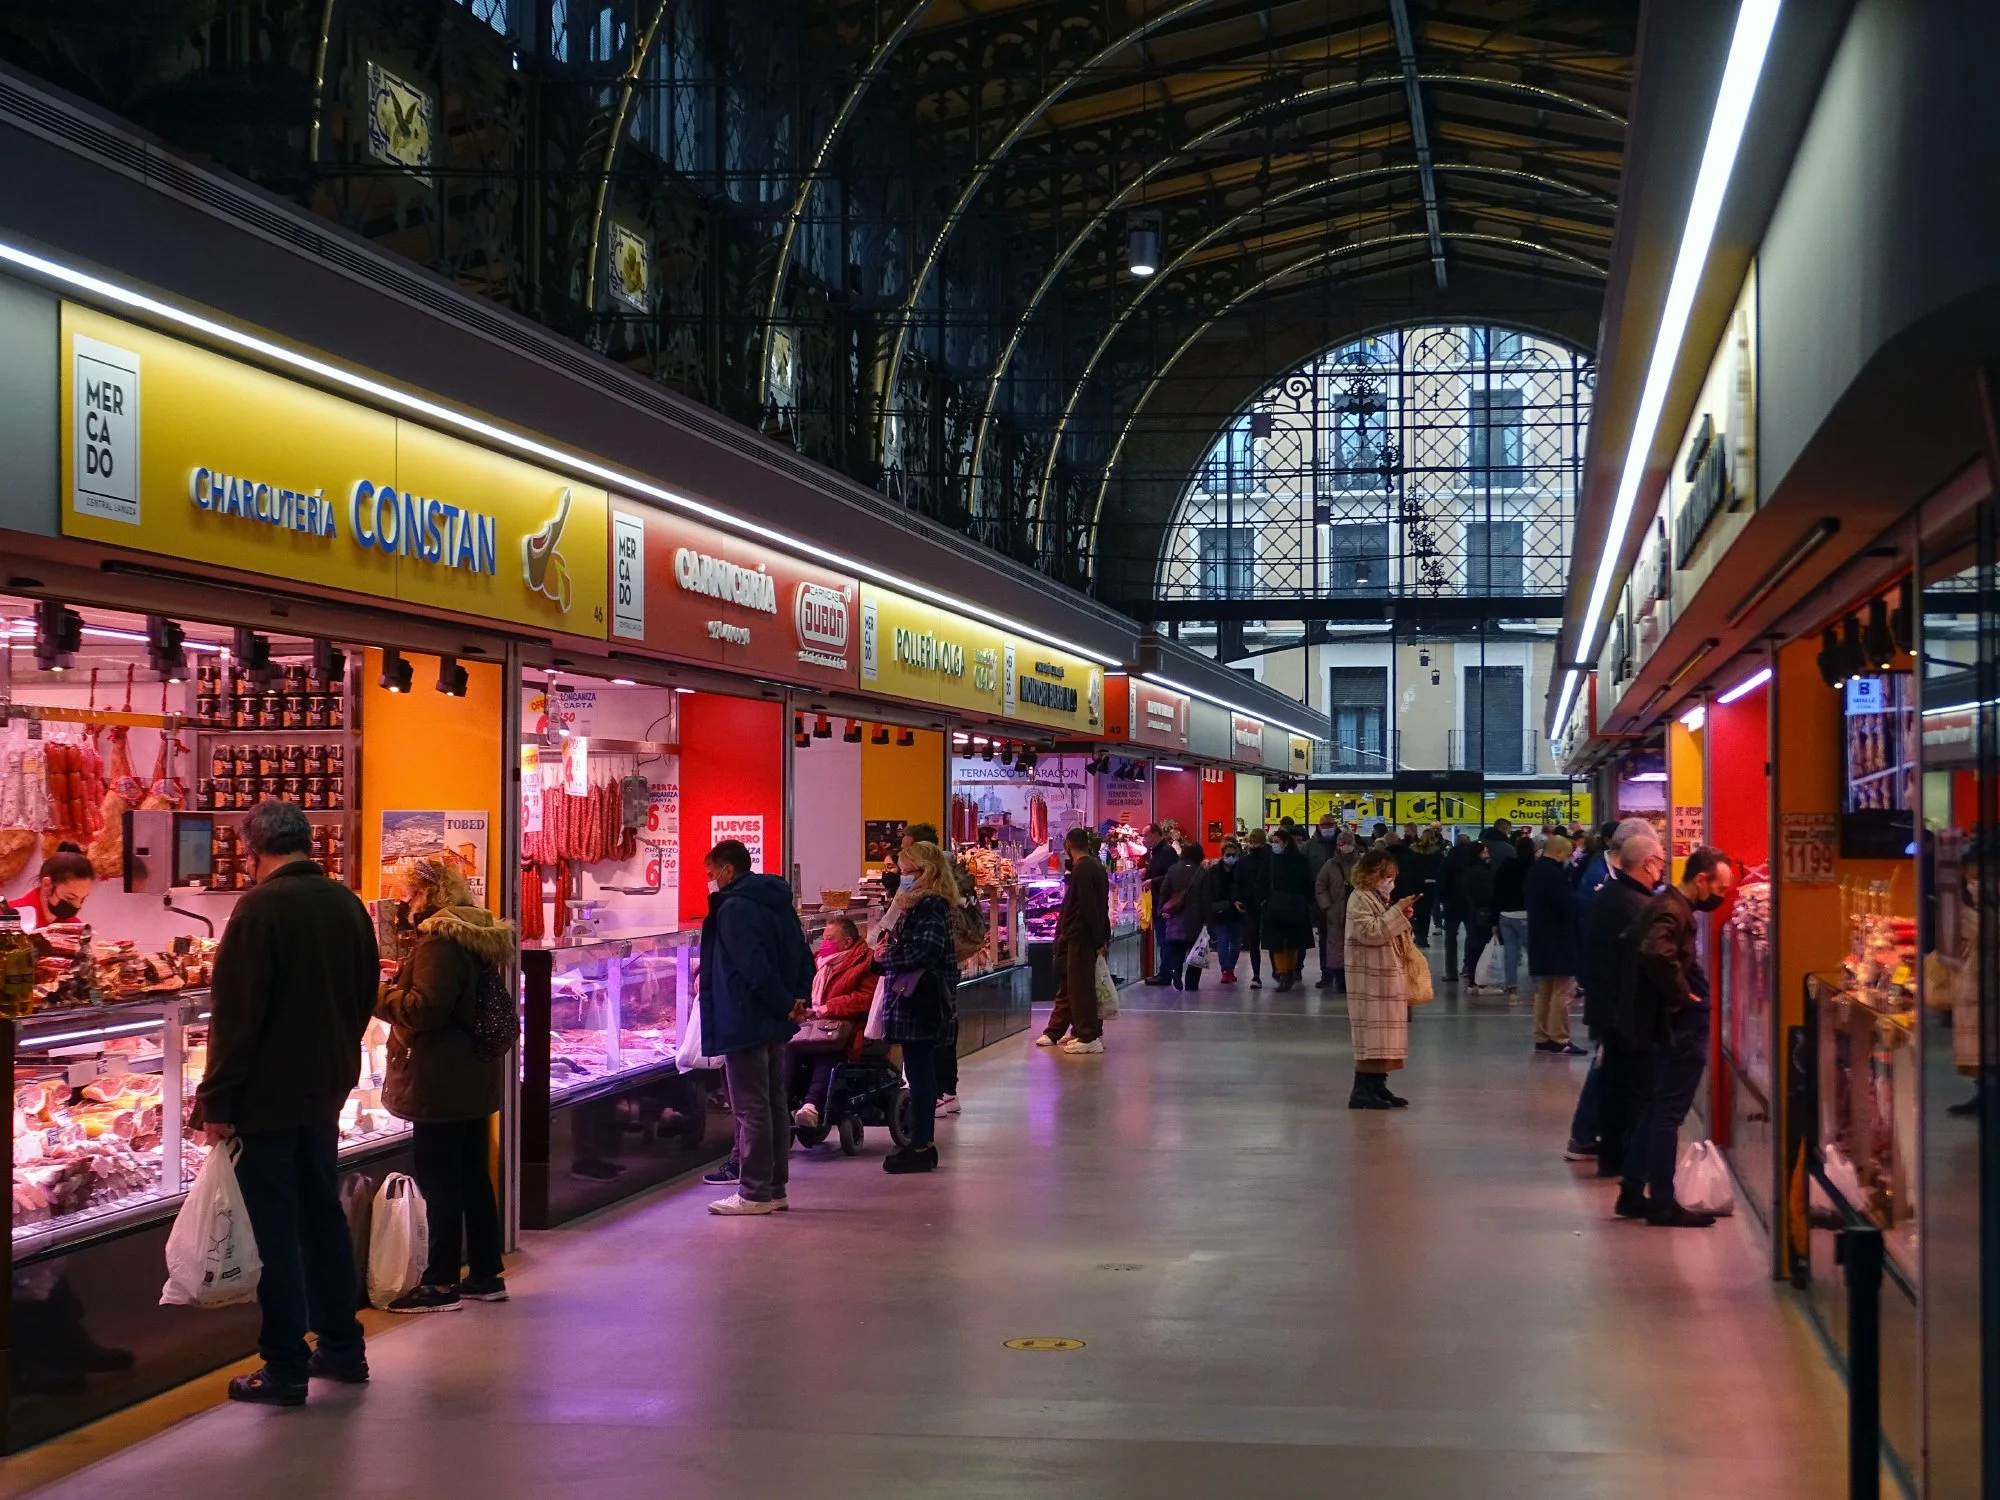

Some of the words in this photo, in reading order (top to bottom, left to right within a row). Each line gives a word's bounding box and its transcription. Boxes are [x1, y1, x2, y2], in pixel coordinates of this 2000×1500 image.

[86, 376, 124, 415] MER
[86, 411, 111, 445] CA
[87, 443, 113, 478] DO
[190, 467, 336, 538] CHARCUTERÍA
[350, 479, 496, 576] CONSTAN
[619, 536, 637, 560] MER
[619, 559, 630, 582] CA
[675, 547, 778, 614] CARNICERÍA
[619, 583, 632, 606] DO
[593, 605, 604, 623] 46
[892, 628, 939, 671] POLLERÍA
[940, 641, 965, 677] OLGA
[560, 692, 597, 701] LONGANIZA
[1109, 726, 1121, 734] 42
[960, 768, 1015, 778] TERNASCO
[1036, 767, 1079, 778] ARAGÓN
[647, 804, 660, 832] 6
[1686, 806, 1703, 816] RESP
[446, 819, 485, 830] TOBED
[714, 821, 760, 831] JUEVES
[649, 839, 678, 847] FERTA
[645, 859, 660, 887] 6
